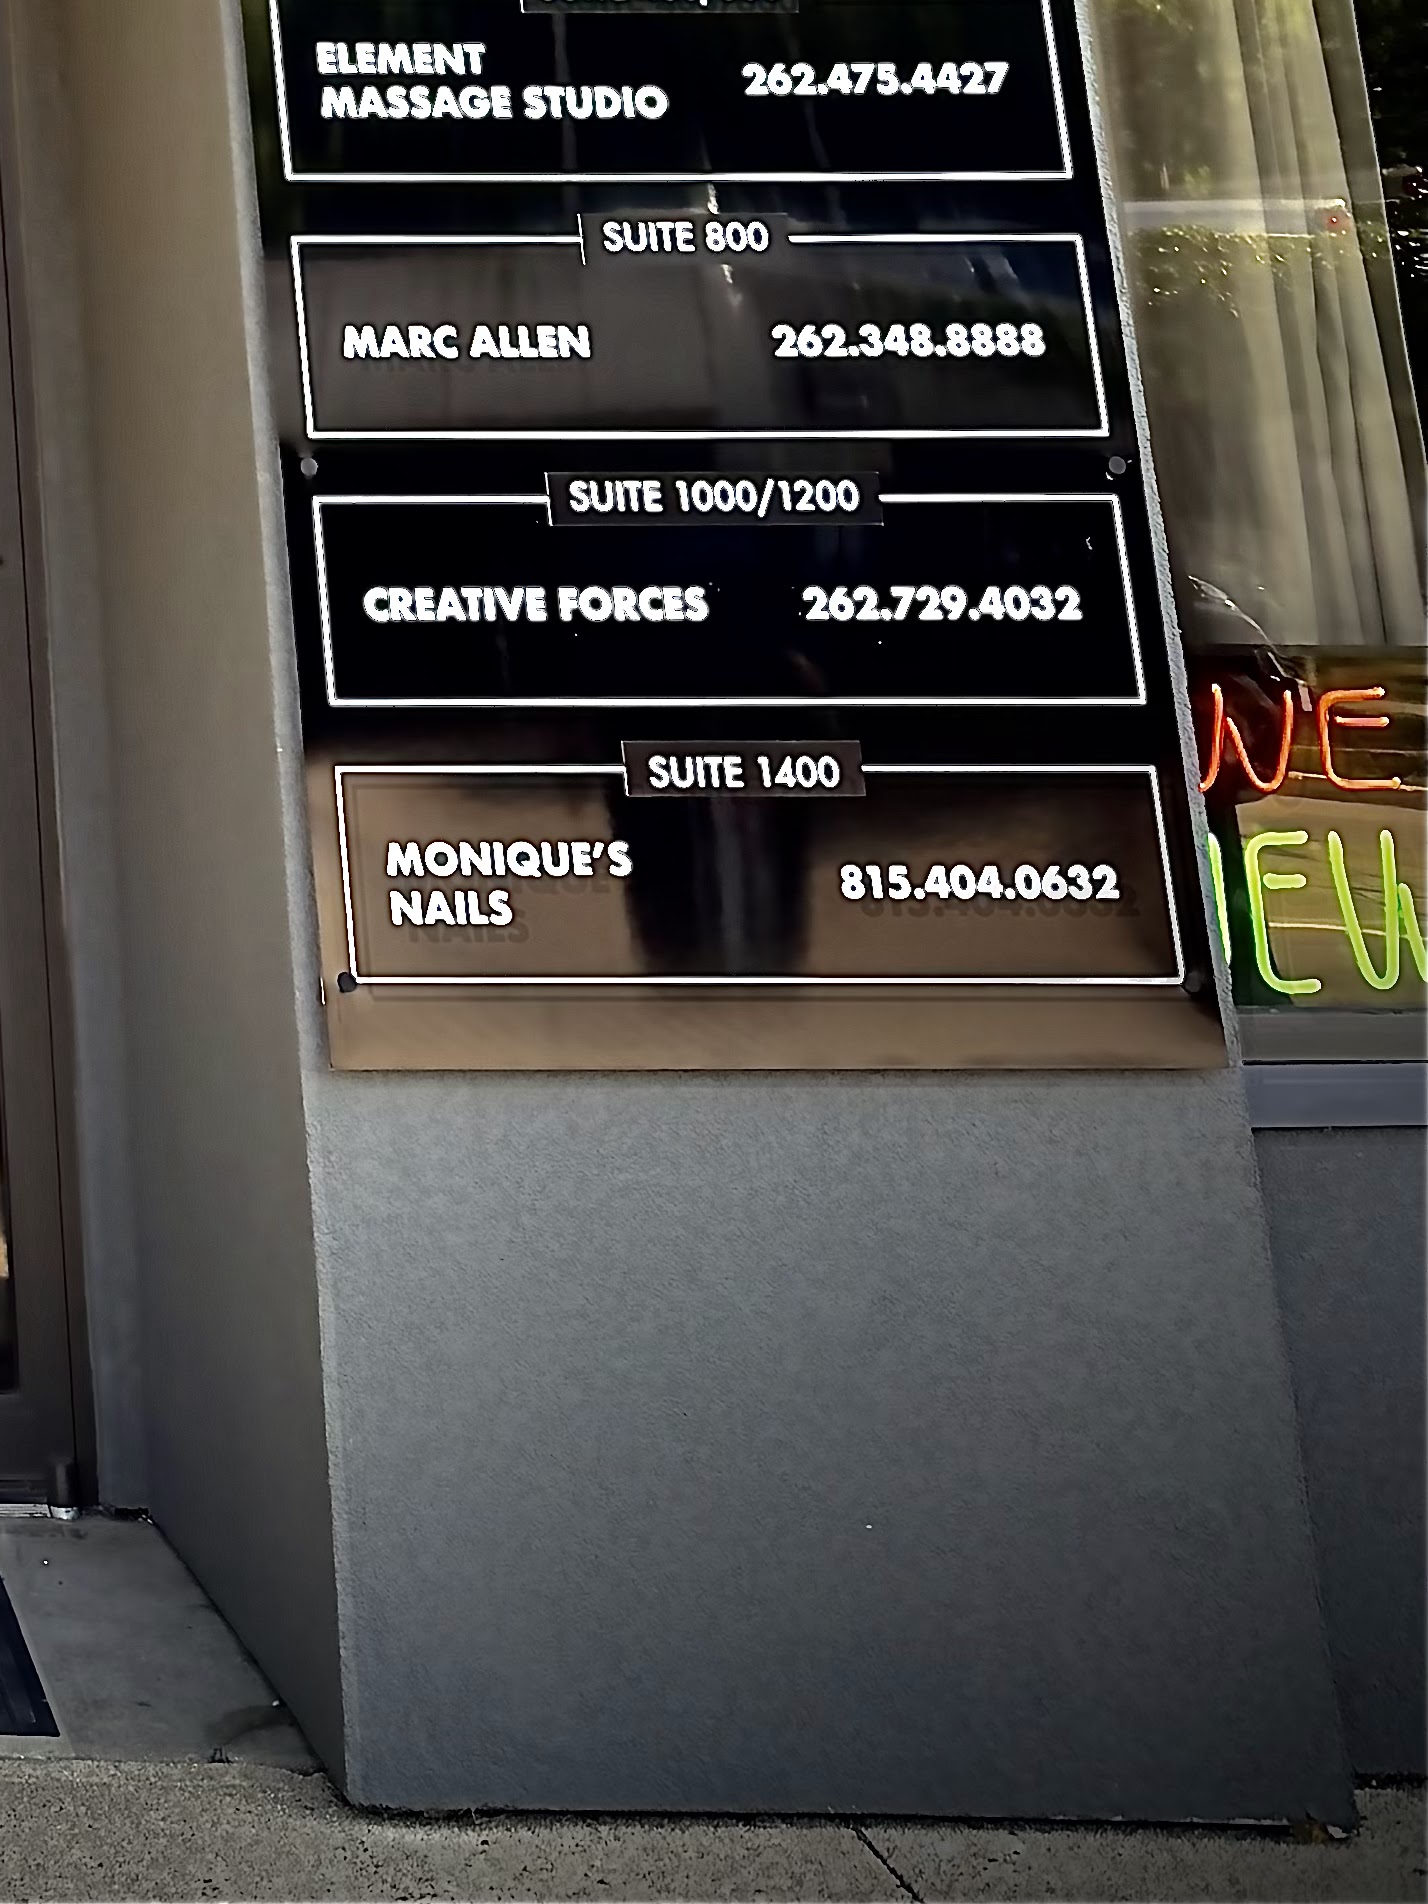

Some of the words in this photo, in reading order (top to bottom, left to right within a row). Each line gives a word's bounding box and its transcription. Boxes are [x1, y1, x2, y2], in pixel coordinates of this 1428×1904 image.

[316, 41, 486, 75] ELEMENT
[320, 85, 513, 119] MASSAGE
[523, 85, 669, 120] STUDIO
[742, 61, 1009, 96] 262.475.4427
[602, 221, 696, 252] SUITE
[705, 221, 769, 252] 800
[343, 324, 459, 359] MARC
[469, 325, 591, 358] ALLEN
[771, 323, 1046, 358] 262.348.8888
[569, 480, 664, 513] SUITE
[675, 478, 860, 518] 1000/1200
[363, 586, 548, 623] CREATIVE
[558, 586, 709, 622] FORCES
[802, 585, 1083, 621] 262.729.4032
[648, 755, 745, 789] SUITE
[756, 755, 840, 788] 1400
[386, 841, 633, 878] MONIQUE'S
[389, 889, 513, 926] NAILS
[840, 864, 1120, 900] 815.404.0632
